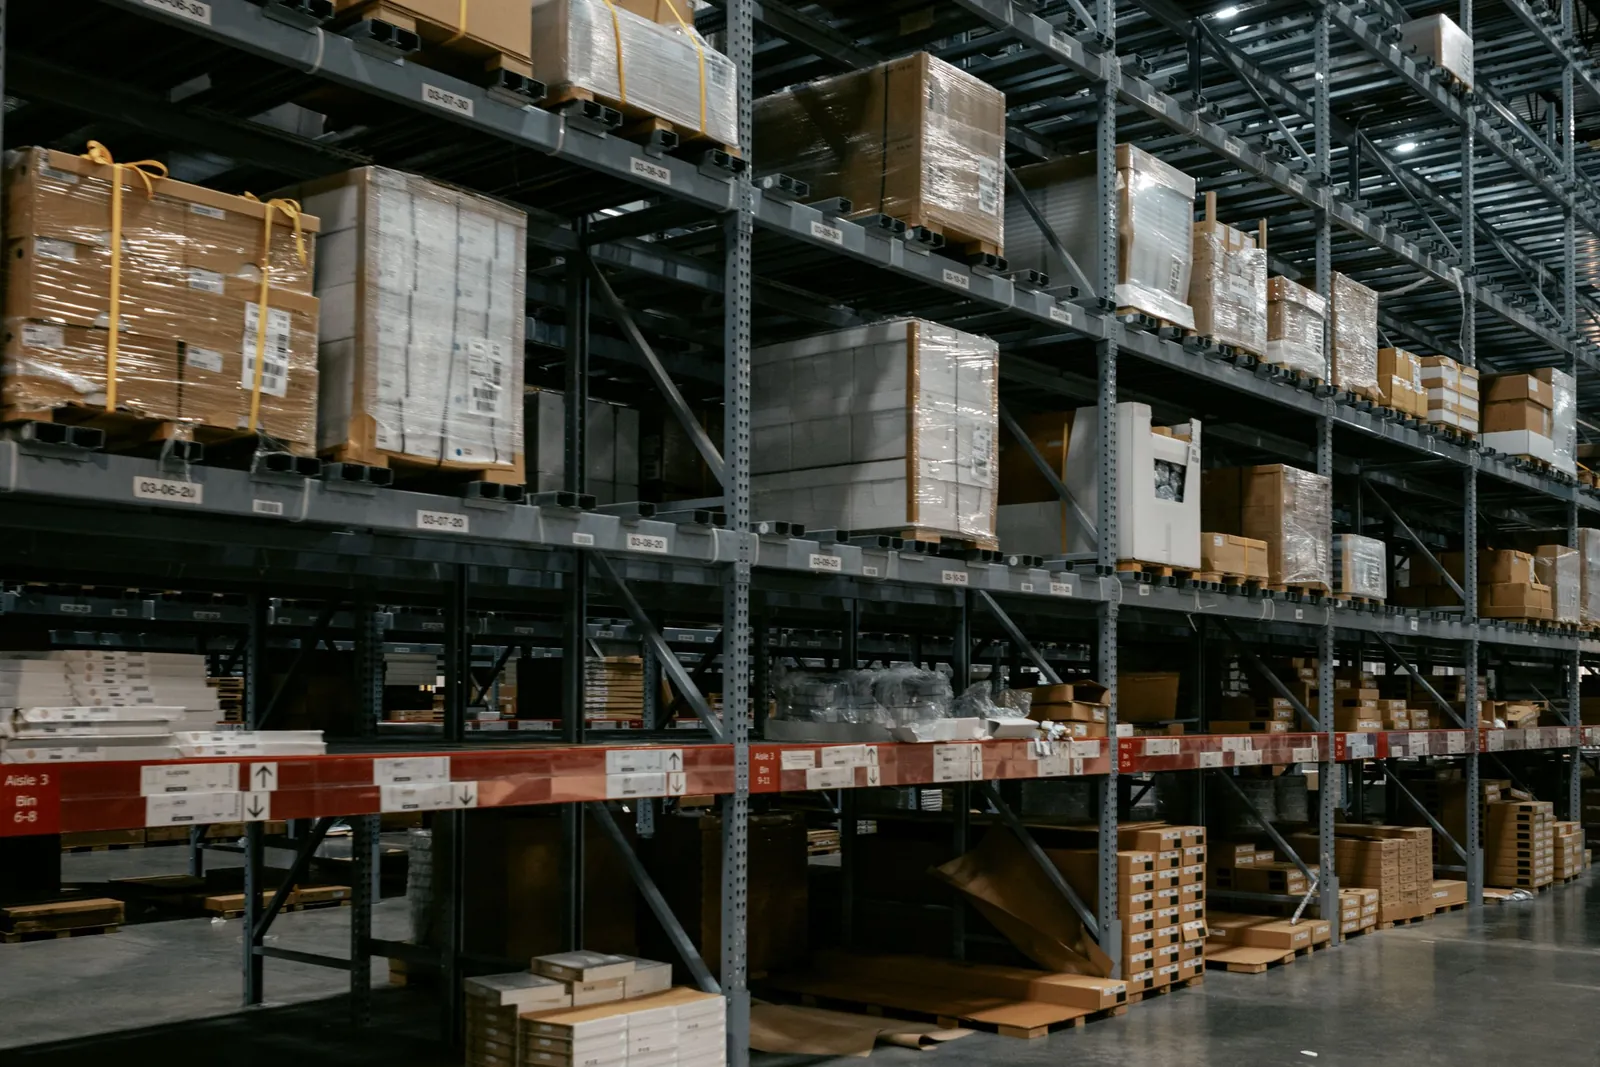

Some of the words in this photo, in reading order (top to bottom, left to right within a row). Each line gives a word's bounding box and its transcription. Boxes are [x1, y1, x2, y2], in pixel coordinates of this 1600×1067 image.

[427, 87, 469, 111] 03-07-30
[140, 481, 197, 498] 03-06-20
[422, 513, 464, 529] 03-07-20
[754, 752, 769, 761] Aisle
[769, 752, 775, 760] 3
[759, 766, 769, 774] Bin
[4, 774, 37, 786] Aisle
[39, 774, 50, 786] 3
[15, 795, 38, 807] Bin
[13, 810, 38, 823] 6-8
